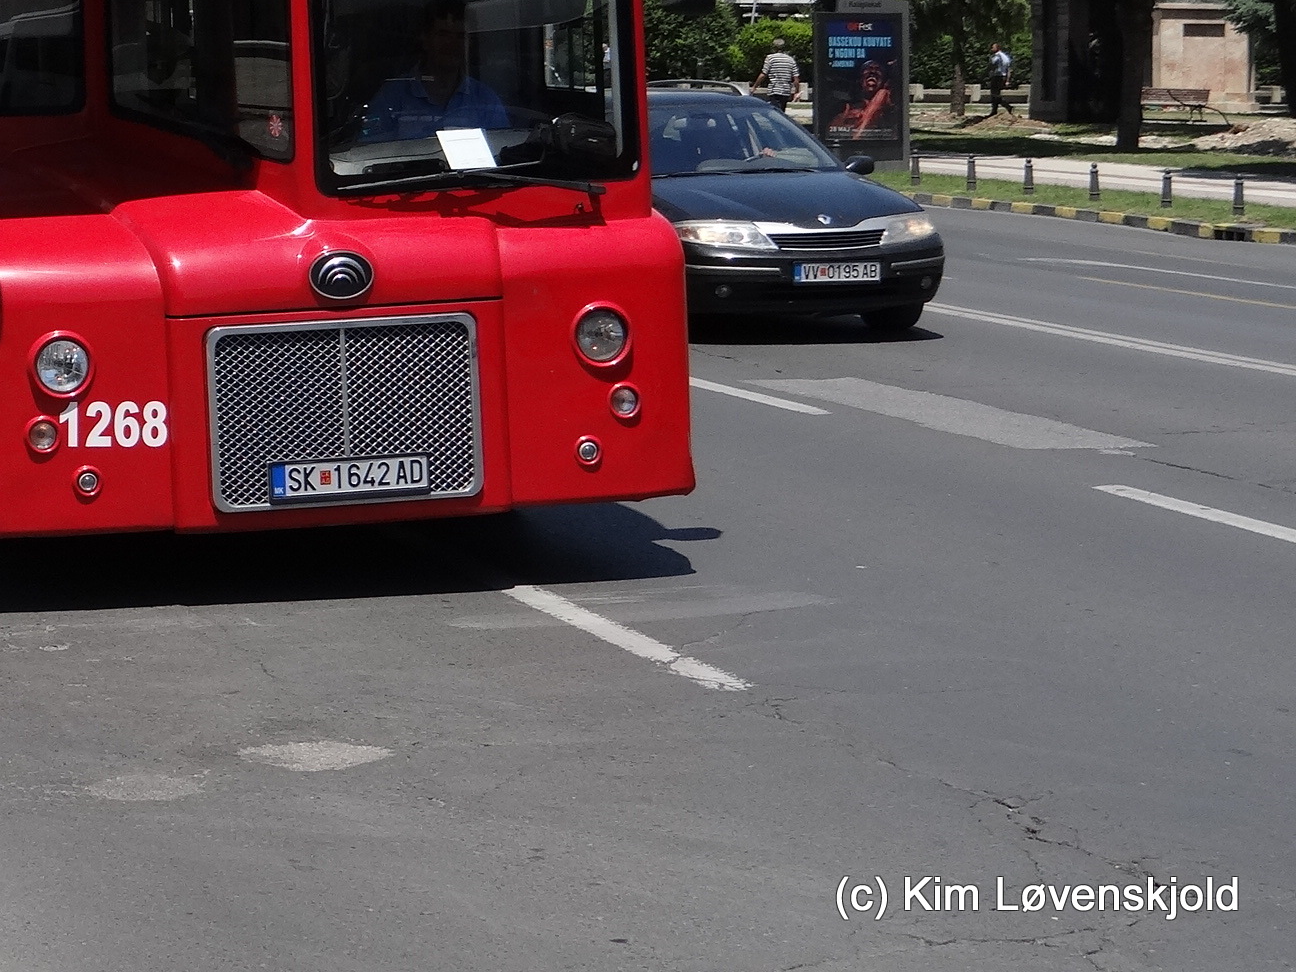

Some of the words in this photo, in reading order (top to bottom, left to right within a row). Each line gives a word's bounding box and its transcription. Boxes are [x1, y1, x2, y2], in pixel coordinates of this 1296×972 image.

[827, 264, 859, 279] 0195
[862, 264, 878, 279] AB
[58, 401, 168, 448] 1268
[288, 465, 317, 492] SK
[334, 461, 391, 489] 1642
[396, 459, 423, 485] AD
